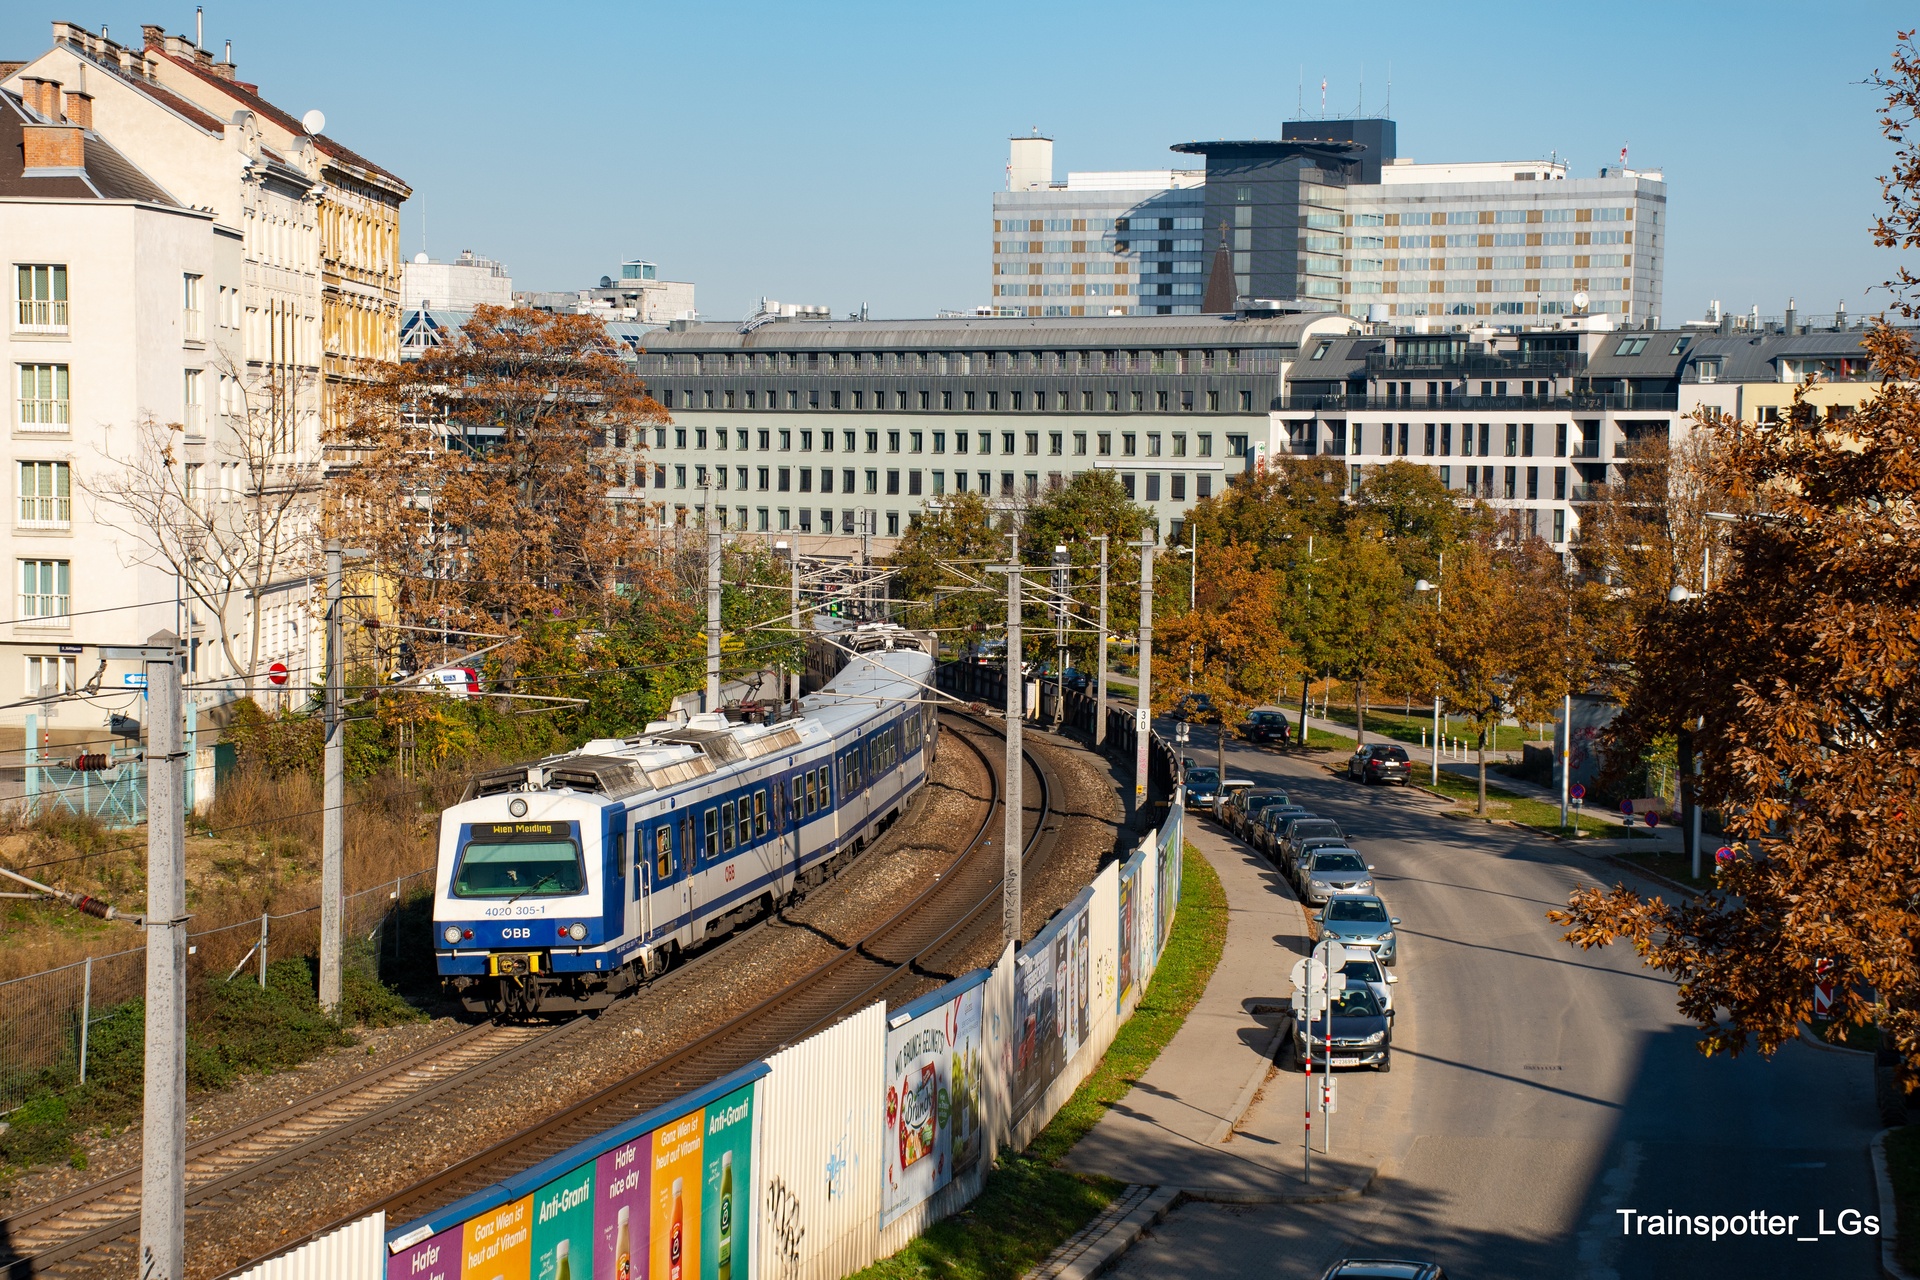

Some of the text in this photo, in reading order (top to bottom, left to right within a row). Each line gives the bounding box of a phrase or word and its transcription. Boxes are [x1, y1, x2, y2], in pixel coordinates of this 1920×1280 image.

[493, 824, 552, 834] Wien Meidling
[485, 905, 545, 917] 4020 305-1
[502, 927, 531, 939] ÖBB
[708, 1096, 749, 1136] Anti-Granti
[905, 1086, 932, 1124] Brunch
[661, 1130, 676, 1147] Ganz
[677, 1122, 690, 1139] Wien
[615, 1144, 636, 1170] Hafer
[656, 1135, 700, 1170] heut auf Vitamin
[609, 1169, 640, 1199] nice day
[538, 1177, 590, 1225] Anti-Granti
[475, 1204, 524, 1242] Ganz Wien ist
[412, 1244, 440, 1275] Hafer
[467, 1226, 527, 1270] heut auf Vitamin
